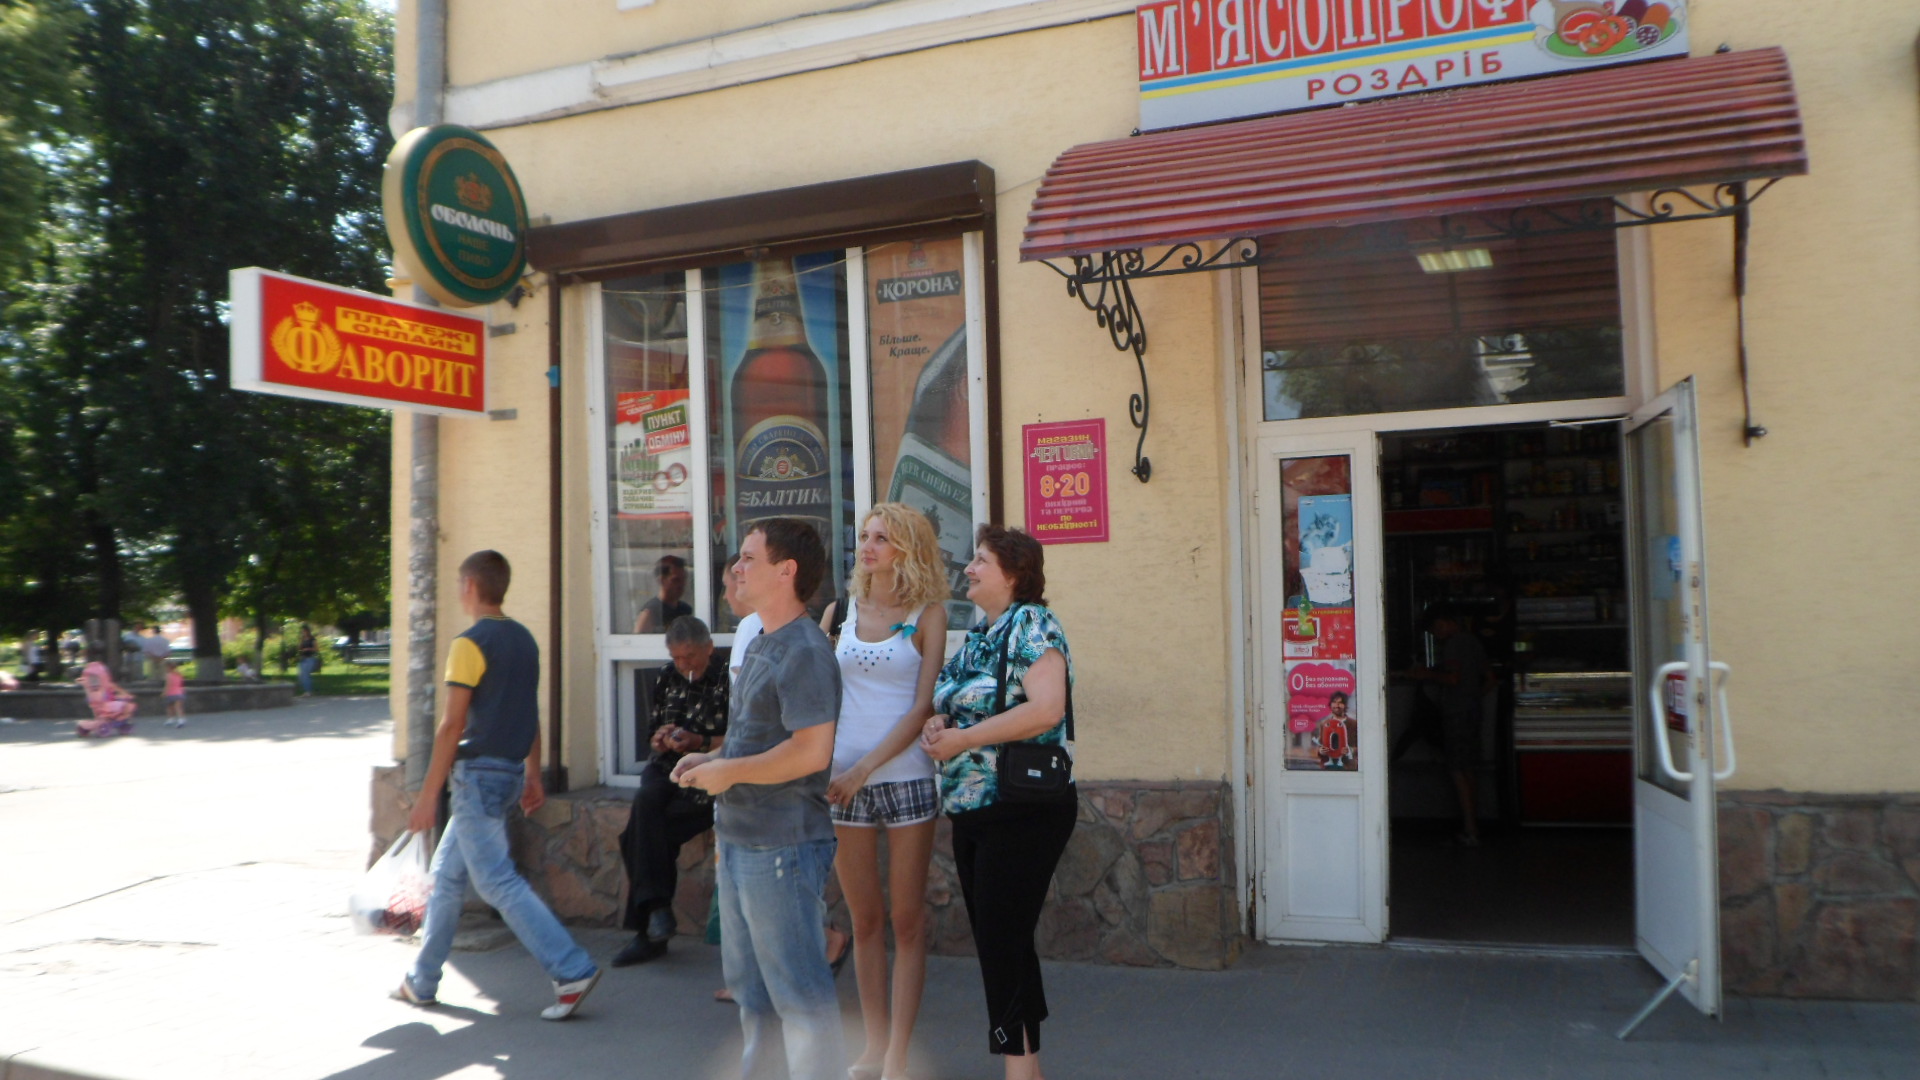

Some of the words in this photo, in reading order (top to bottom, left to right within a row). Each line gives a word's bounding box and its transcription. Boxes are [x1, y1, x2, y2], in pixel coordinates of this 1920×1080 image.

[431, 204, 514, 242] ОБОЛОНЬ
[883, 276, 955, 300] КОРОНА
[341, 308, 471, 343] ПЛАТЕЖІ
[284, 321, 476, 398] ФАВОРИТ
[889, 346, 931, 359] Краще.
[647, 410, 681, 431] ПУНКТ
[648, 430, 686, 450] ОБМІНУ
